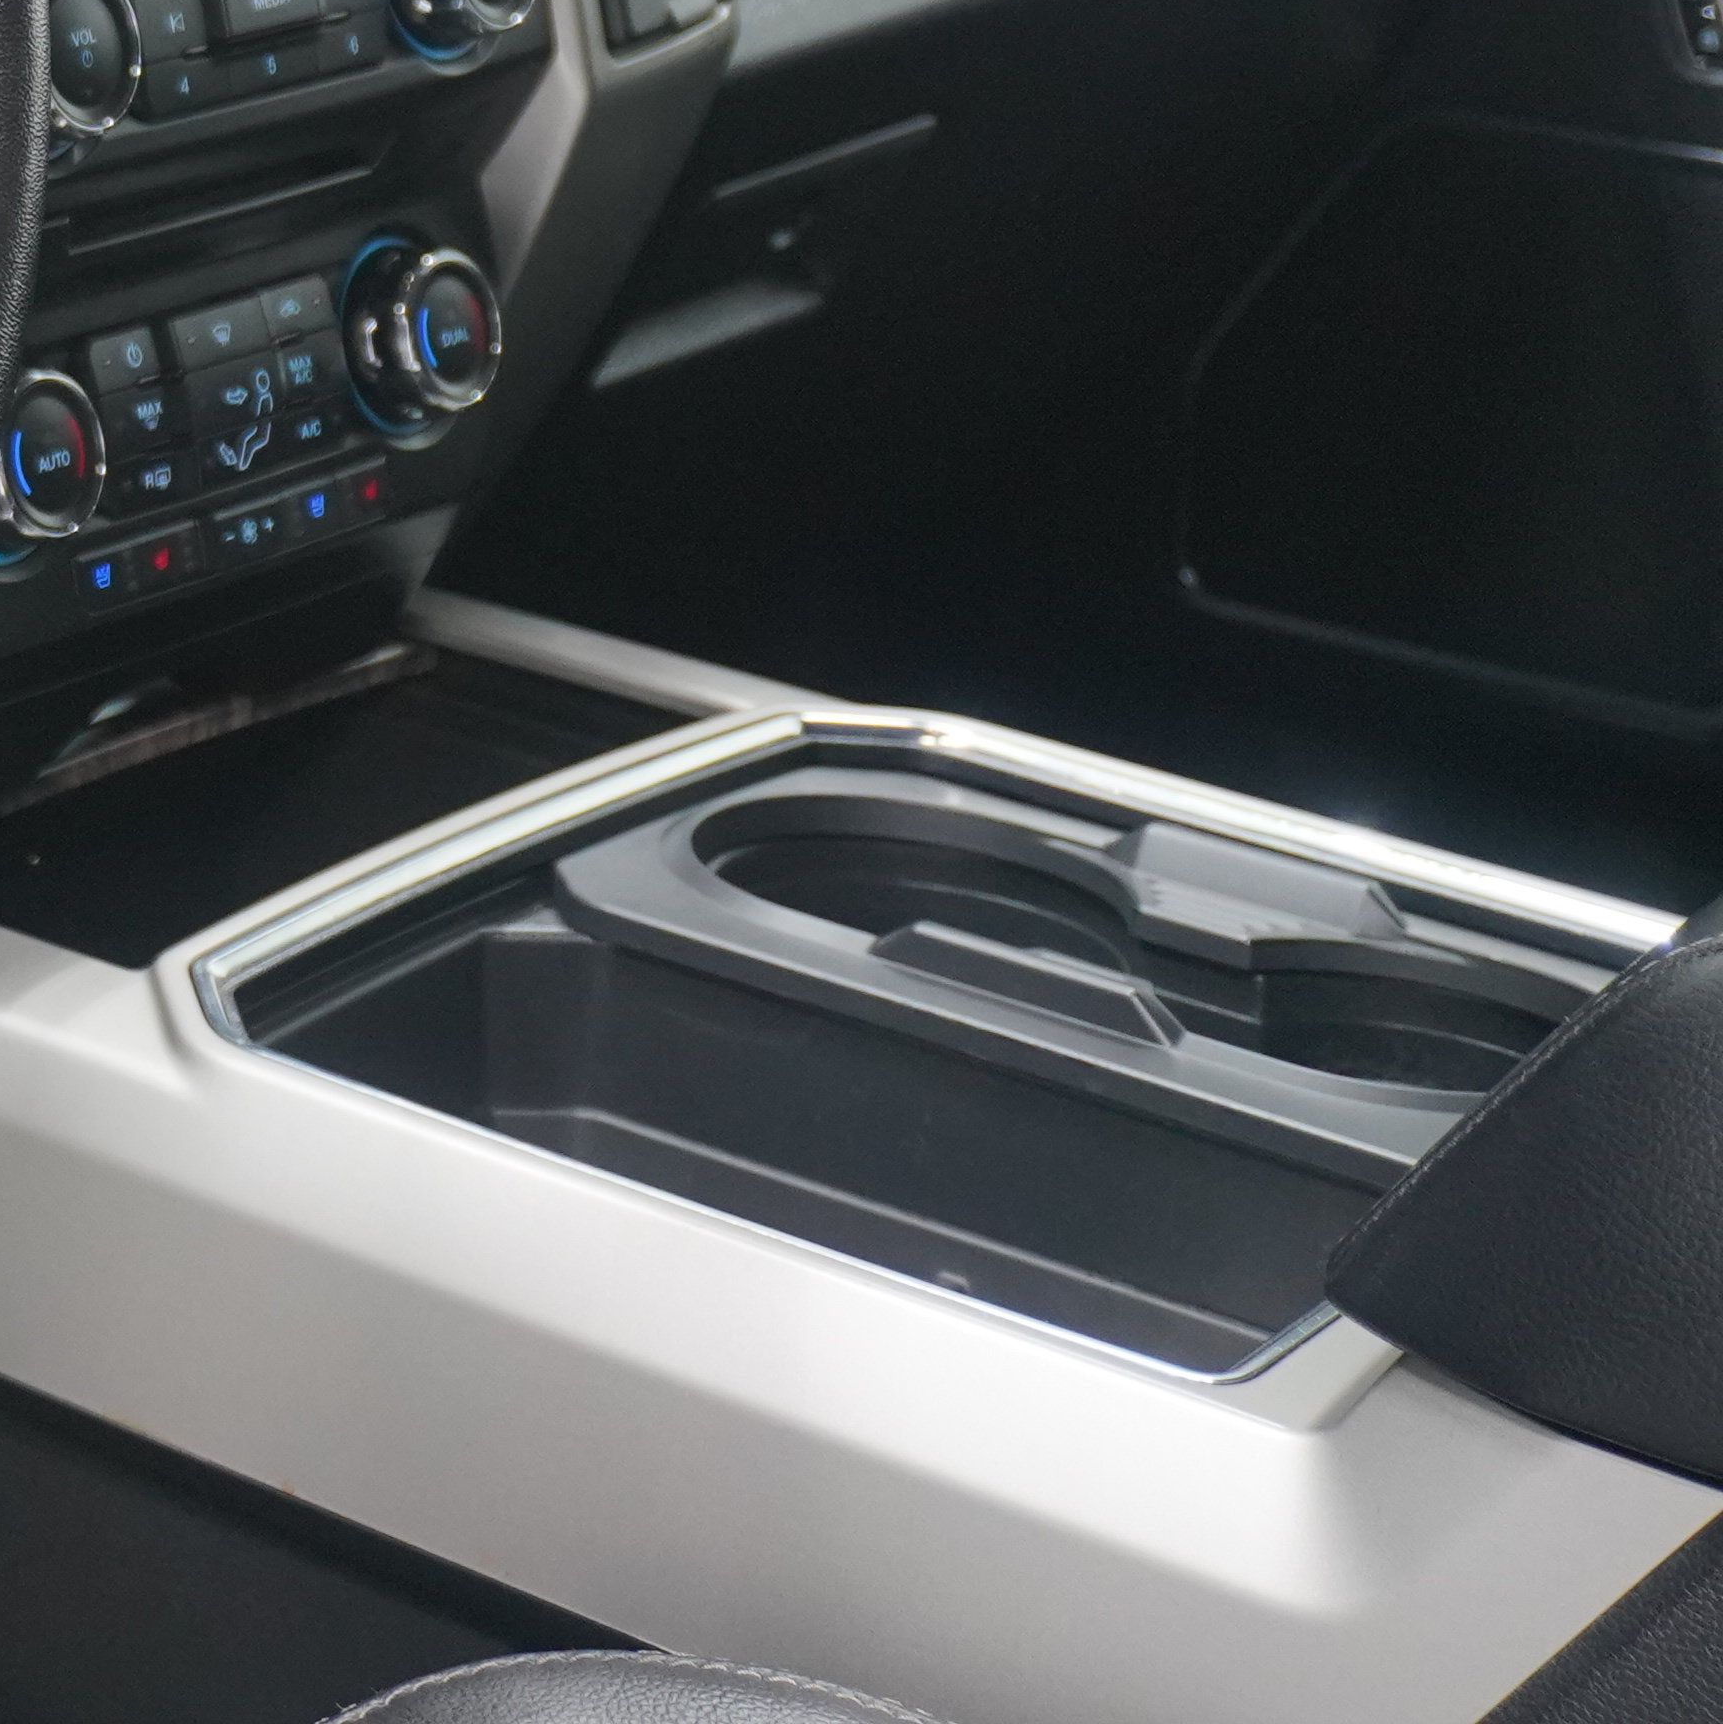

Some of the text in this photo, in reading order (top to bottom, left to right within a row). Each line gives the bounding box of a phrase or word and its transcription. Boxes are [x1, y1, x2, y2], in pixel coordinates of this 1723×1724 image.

[71, 28, 97, 47] VOL
[179, 77, 189, 95] 4
[441, 326, 468, 348] DUAL
[288, 355, 312, 372] MAX
[136, 401, 163, 420] MAX
[299, 420, 322, 441] A/C
[37, 450, 71, 474] AUTO
